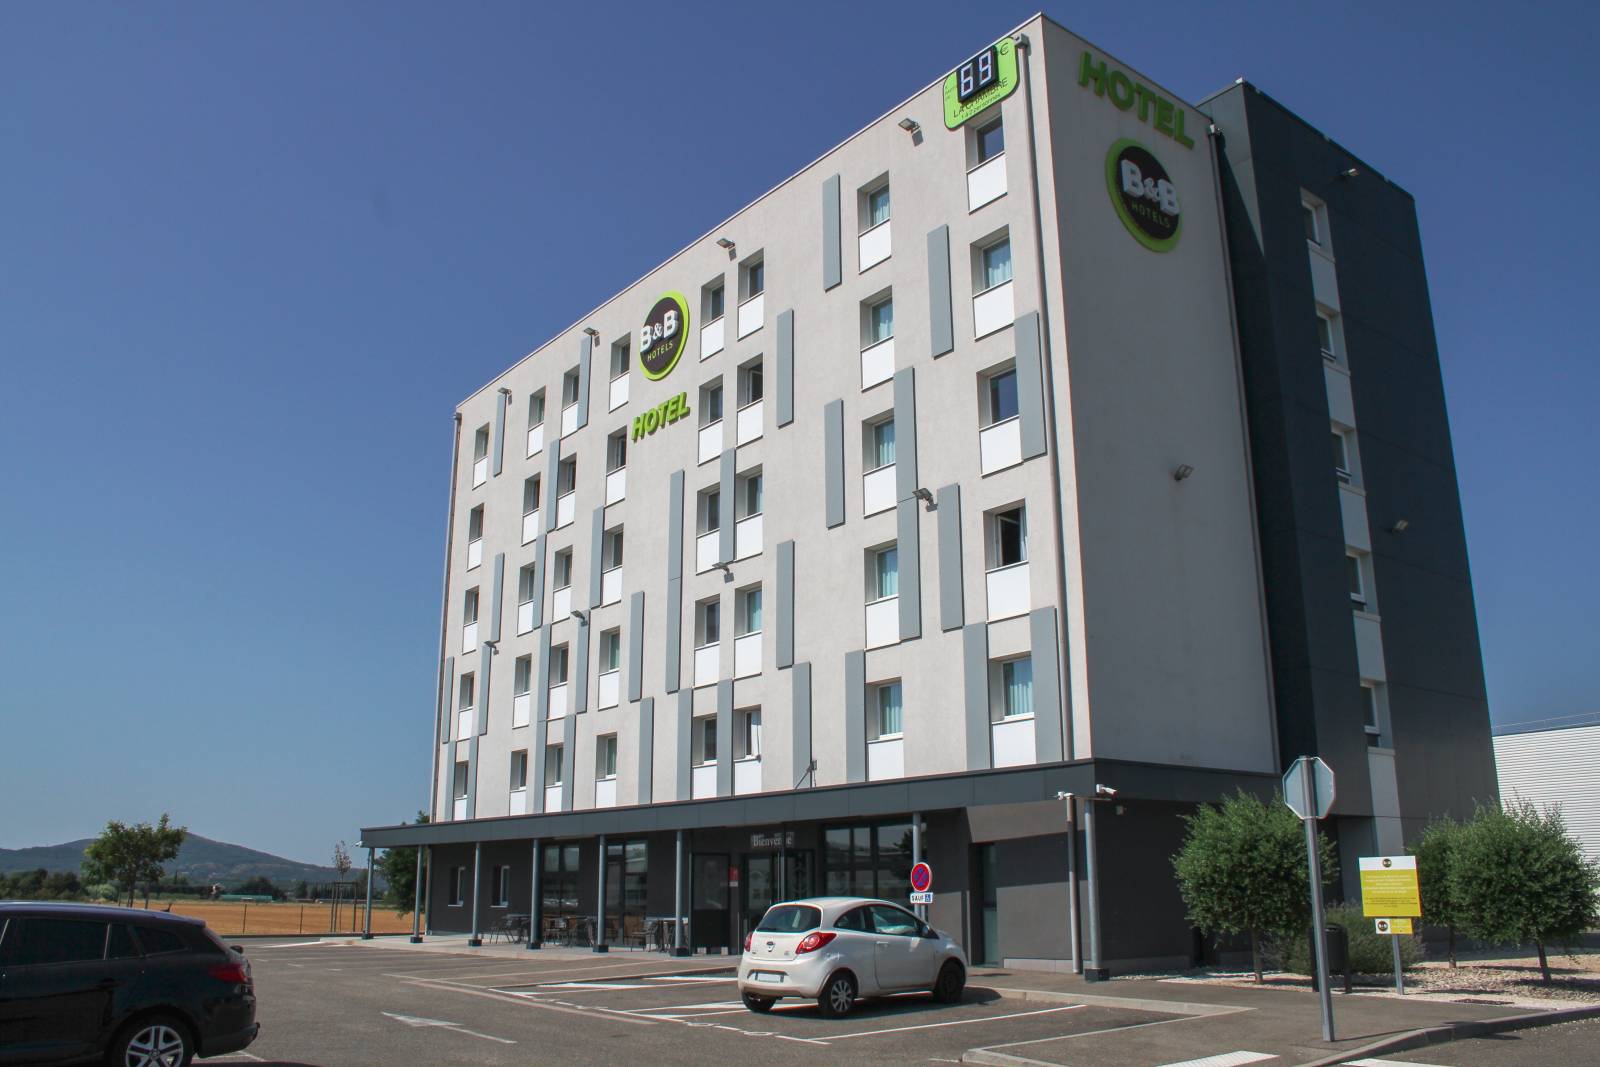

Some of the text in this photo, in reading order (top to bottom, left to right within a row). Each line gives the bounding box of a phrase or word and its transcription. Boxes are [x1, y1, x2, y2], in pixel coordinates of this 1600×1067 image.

[1078, 50, 1194, 150] HOTEL
[1121, 159, 1180, 216] B&B
[1131, 202, 1170, 229] HOTELS
[640, 309, 679, 353] B&B
[647, 341, 674, 362] HOTELS
[631, 391, 690, 442] HOTEL
[911, 894, 924, 902] SAUF
